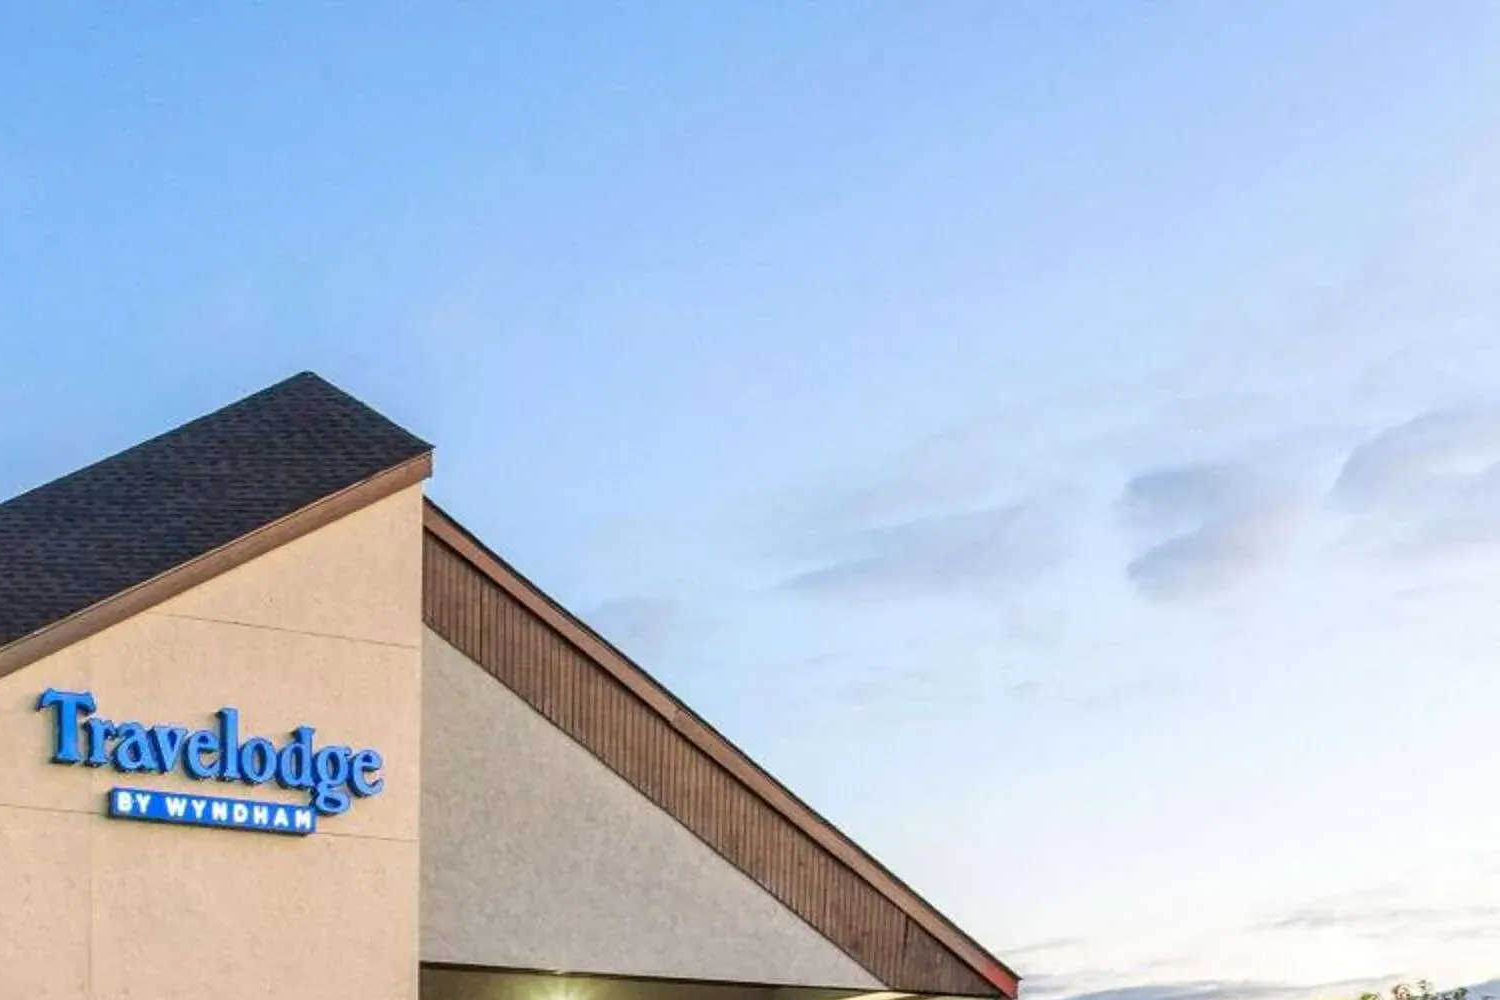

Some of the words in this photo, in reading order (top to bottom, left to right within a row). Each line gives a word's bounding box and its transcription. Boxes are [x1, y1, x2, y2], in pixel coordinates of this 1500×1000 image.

[38, 688, 384, 815] Travelodge
[117, 791, 152, 814] BY
[165, 796, 312, 830] WYNDHAM
